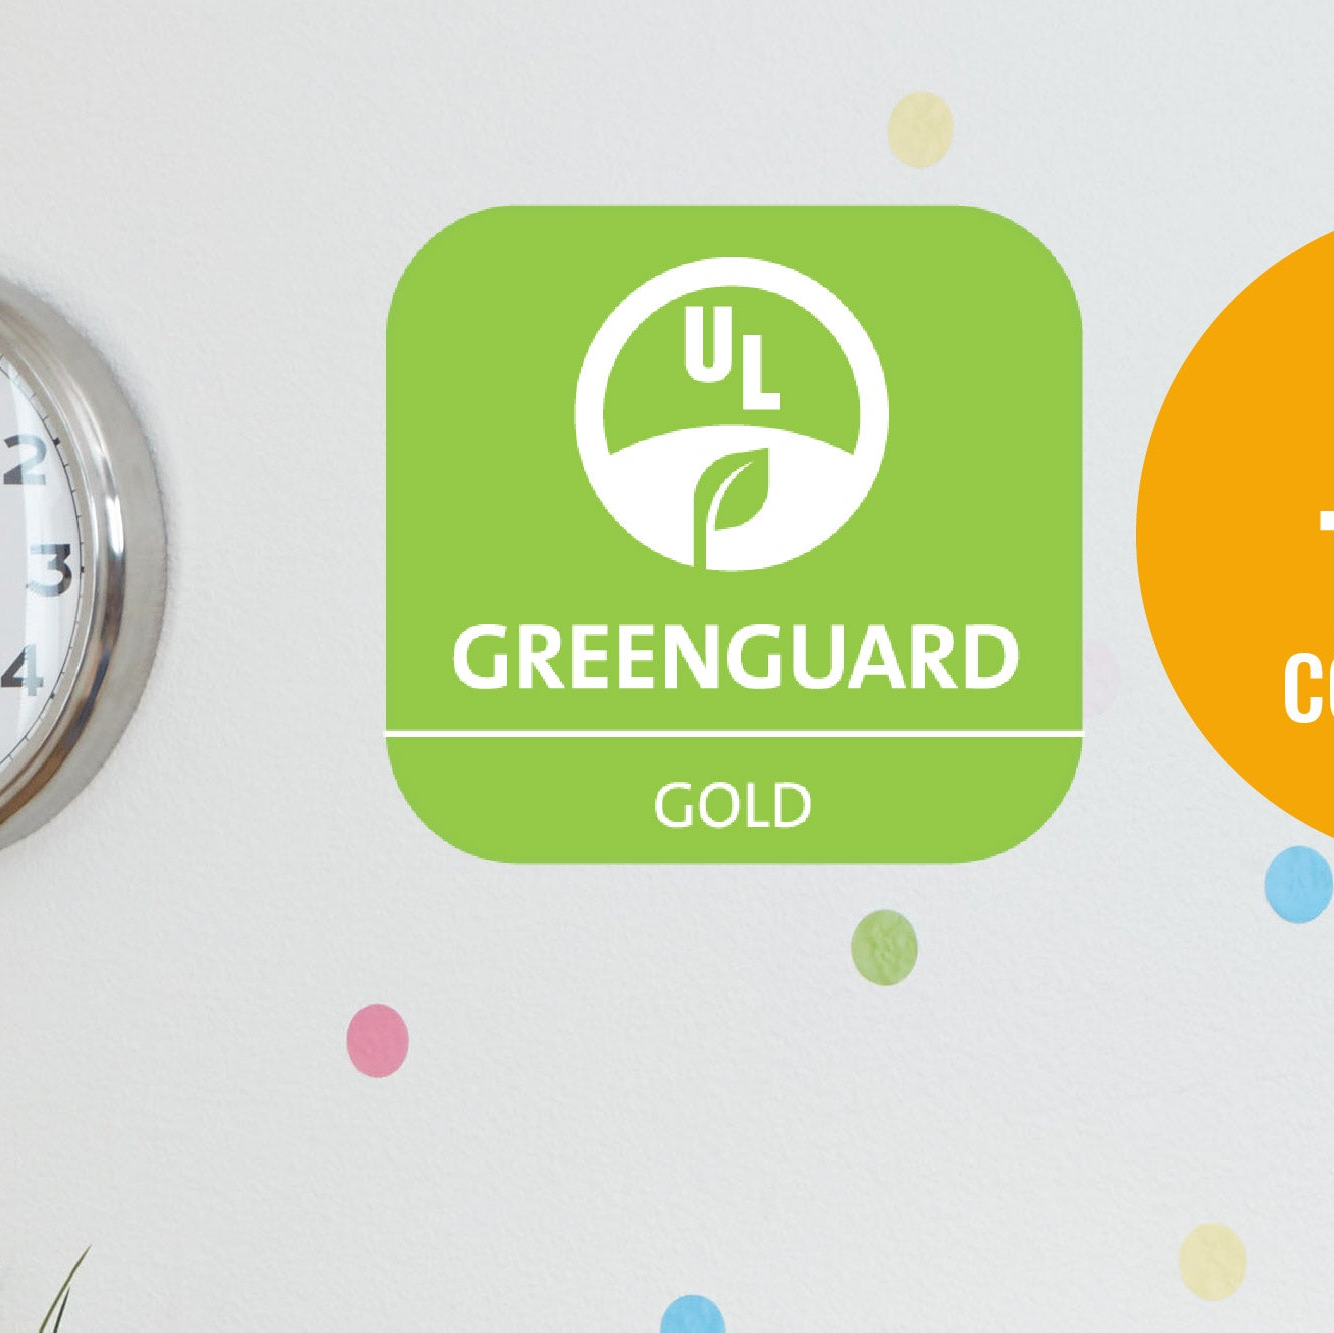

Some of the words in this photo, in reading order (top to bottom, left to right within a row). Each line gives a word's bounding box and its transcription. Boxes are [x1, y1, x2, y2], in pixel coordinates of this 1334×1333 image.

[4, 434, 47, 485] 2
[26, 543, 72, 598] 3
[0, 643, 44, 697] 4
